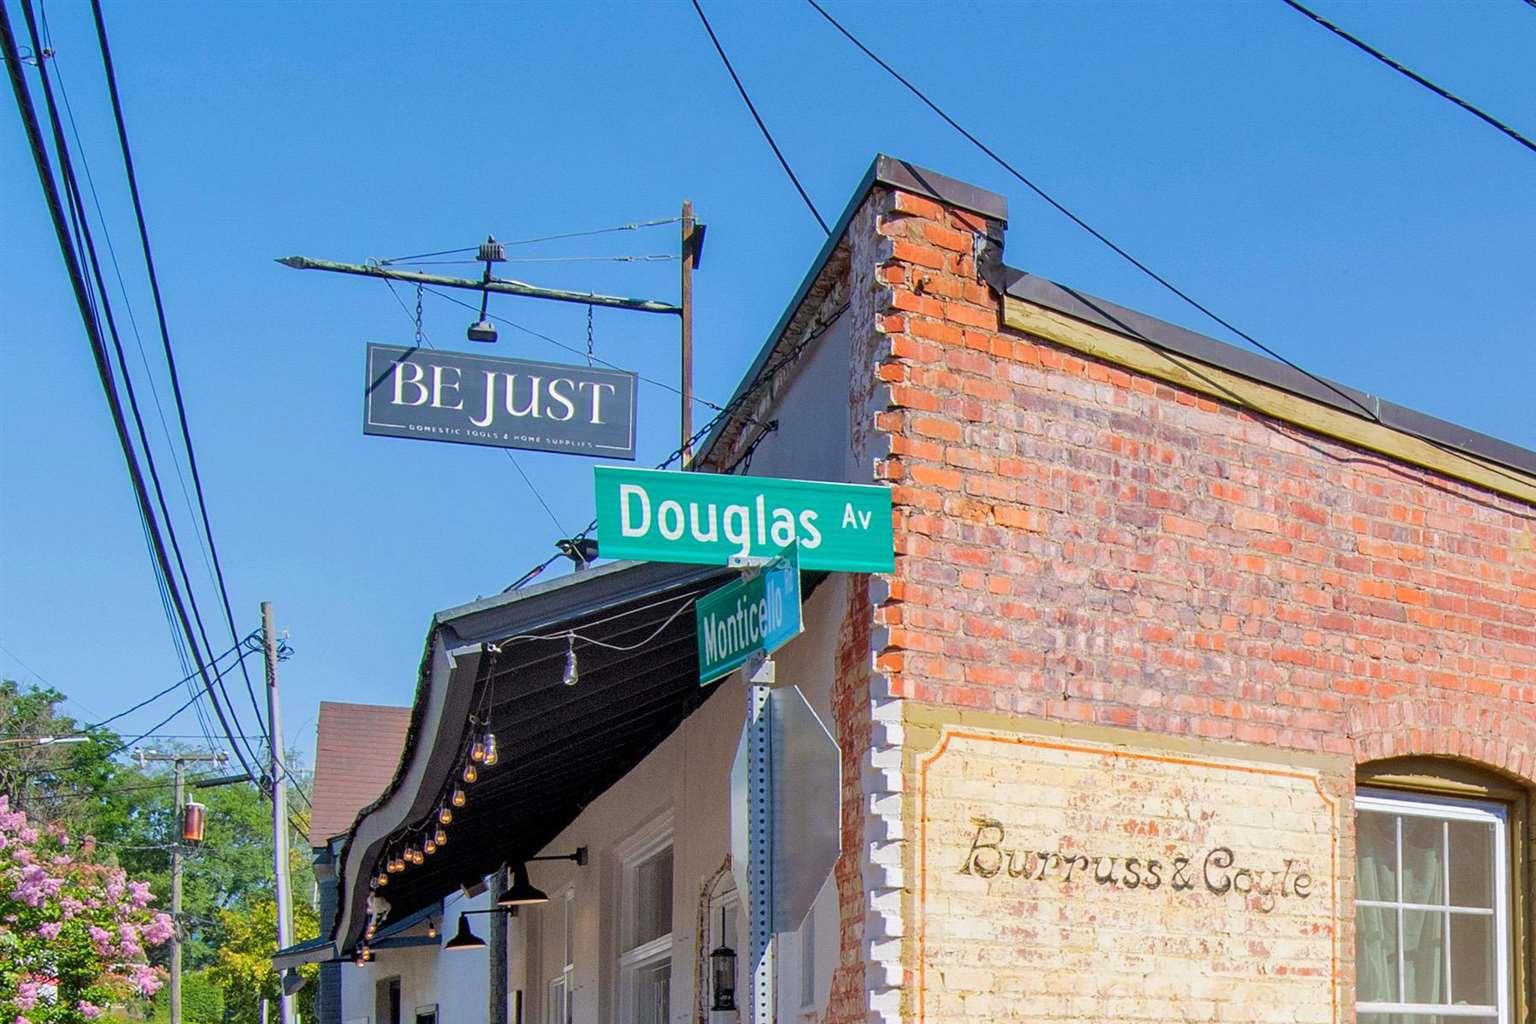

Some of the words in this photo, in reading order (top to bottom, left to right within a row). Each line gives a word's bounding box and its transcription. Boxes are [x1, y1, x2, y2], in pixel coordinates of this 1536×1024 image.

[389, 360, 463, 410] BE
[469, 370, 615, 427] JUST
[409, 423, 461, 436] DOMESTIC
[466, 429, 499, 440] TOOLS
[514, 435, 540, 444] HOME
[546, 438, 593, 449] SUPPLIES
[620, 483, 823, 559] Douglas
[842, 503, 872, 530] Av
[703, 579, 782, 667] Monticello
[957, 815, 1162, 890] Burruss
[1171, 856, 1195, 891] &
[1203, 846, 1313, 914] Coyle
